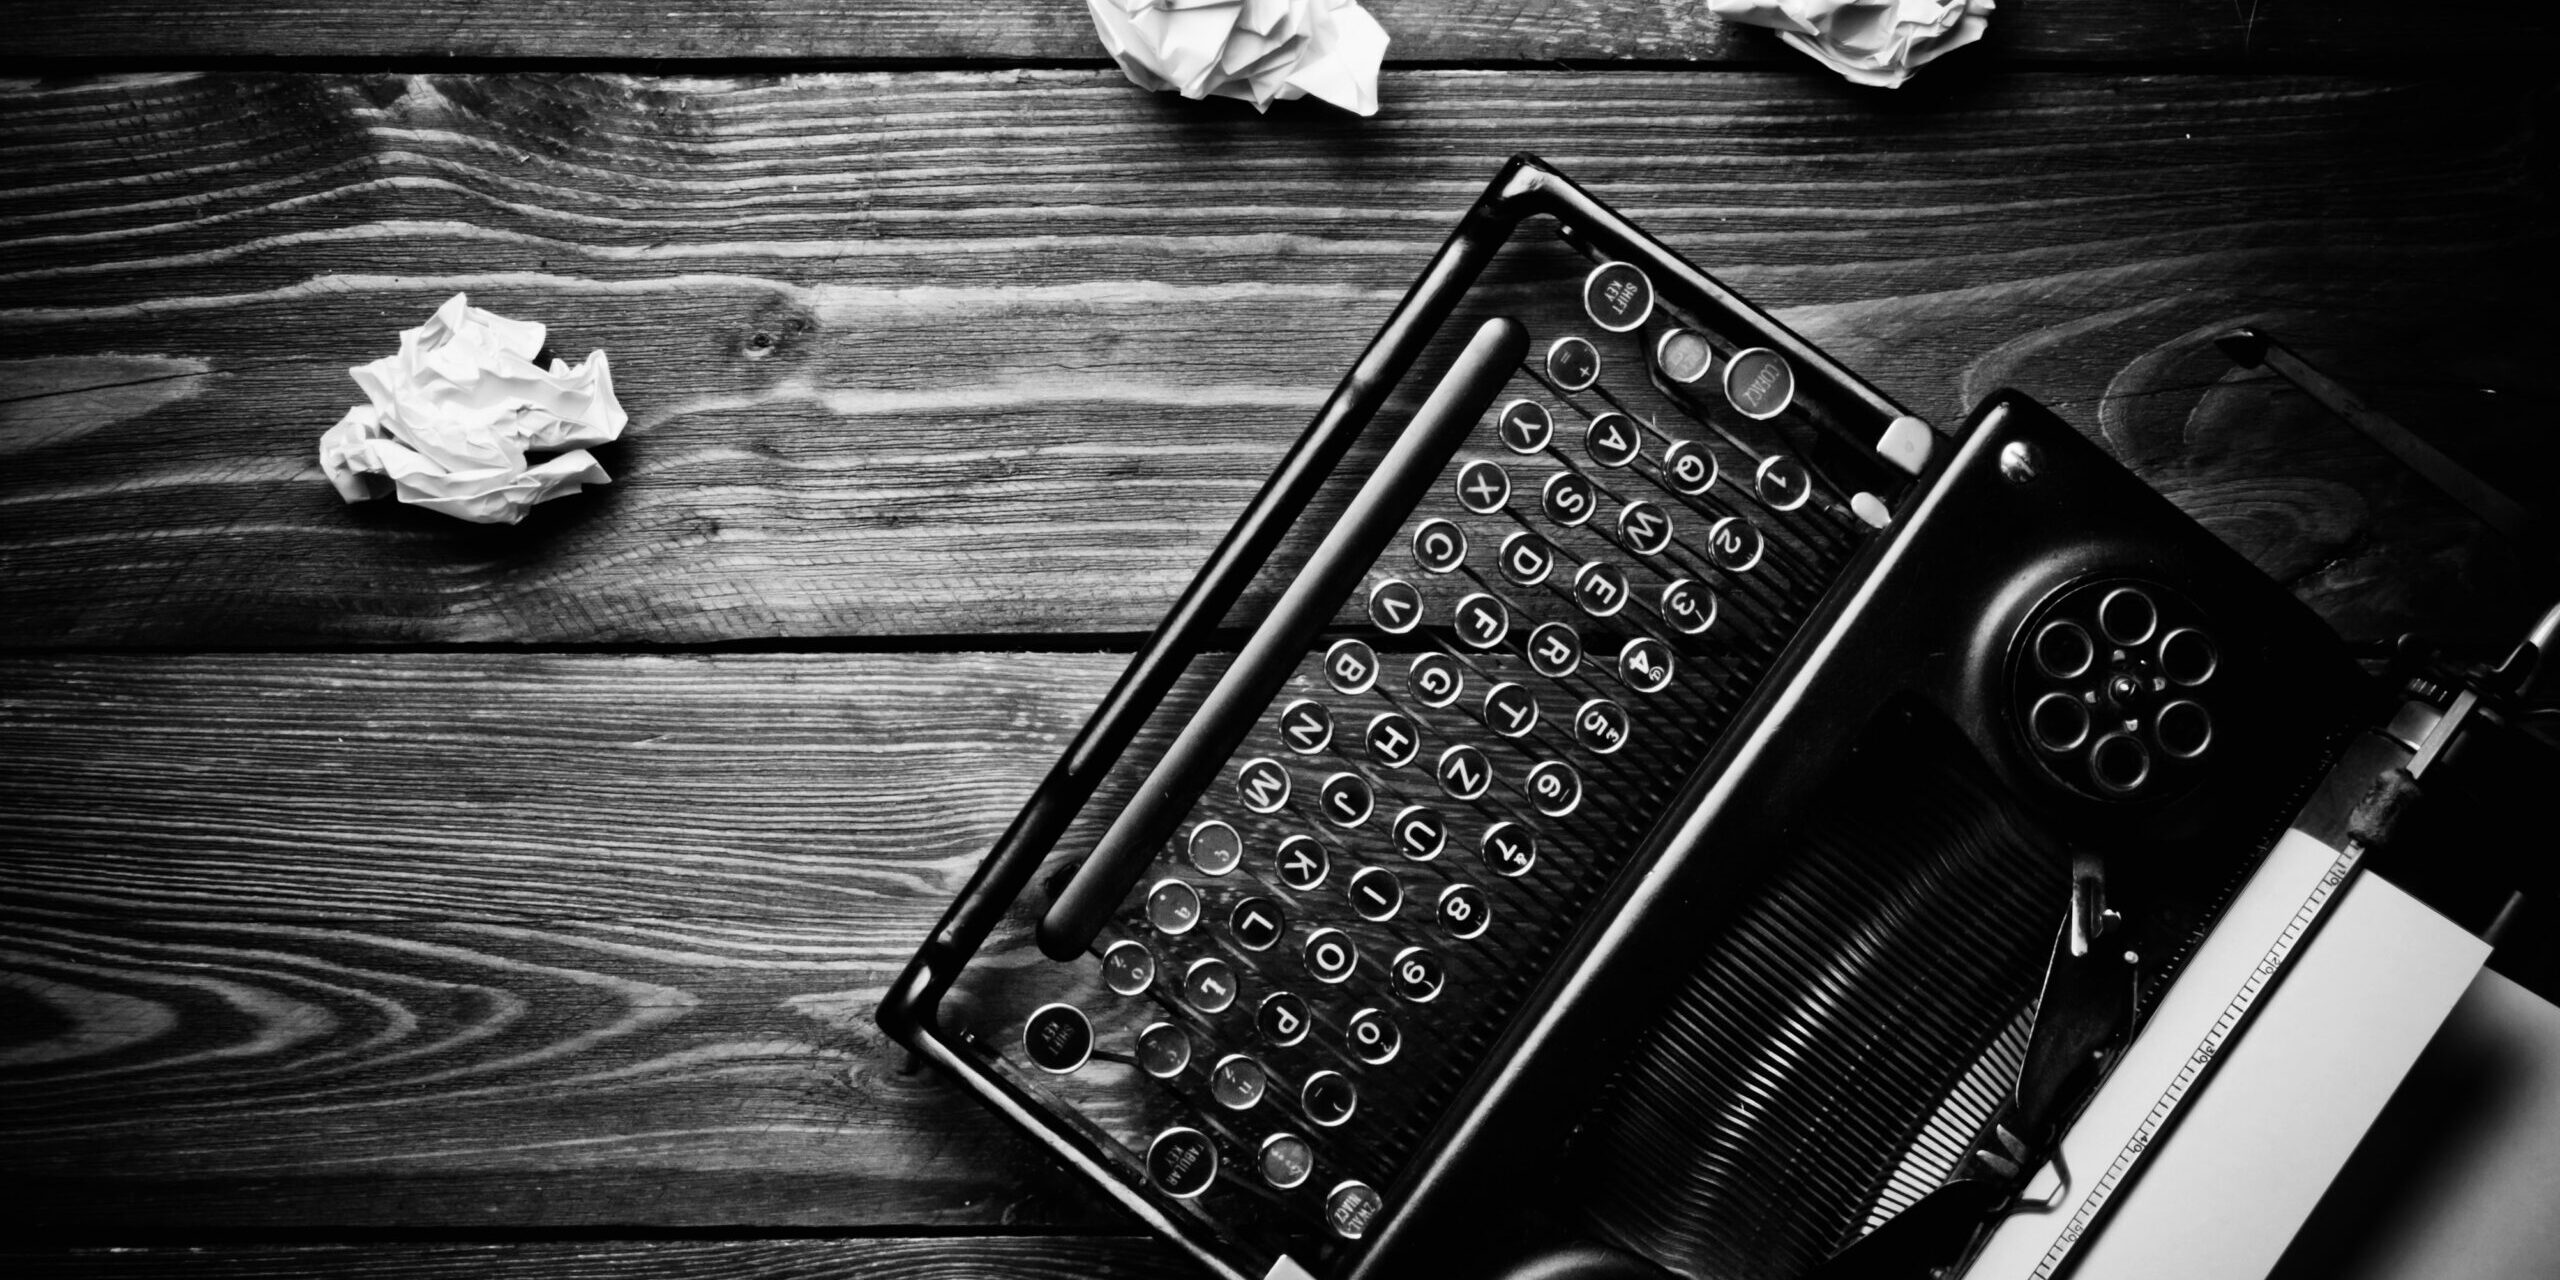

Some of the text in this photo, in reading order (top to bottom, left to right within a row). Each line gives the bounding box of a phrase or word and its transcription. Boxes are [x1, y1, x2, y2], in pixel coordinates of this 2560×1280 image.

[1604, 280, 1623, 302] KEY
[1611, 282, 1638, 315] SHIFT
[1742, 363, 1780, 408] COFACZ
[1512, 416, 1541, 443] Y
[1598, 424, 1627, 451] A
[1674, 455, 1705, 482] Q
[1766, 470, 1786, 488] 1
[1465, 471, 1500, 504] X
[1555, 486, 1584, 513] S
[1626, 511, 1663, 549] W
[1712, 527, 1741, 554] 2
[1424, 532, 1453, 561] C
[1513, 545, 1543, 576] D
[1584, 572, 1617, 604] E
[1382, 597, 1411, 623] V
[1670, 591, 1695, 616] 3
[1473, 607, 1498, 638] F
[1537, 635, 1571, 665] R
[1628, 649, 1650, 674] 4
[1335, 652, 1366, 682] B
[1419, 666, 1451, 695] G
[1288, 711, 1323, 745] N
[1498, 701, 1528, 729] T
[1583, 710, 1609, 736] 5
[1374, 725, 1409, 759] H
[1446, 757, 1480, 791] Z
[1536, 773, 1561, 798] 6
[1244, 769, 1282, 809] M
[1333, 791, 1356, 816] J
[1403, 820, 1436, 852] U
[1494, 837, 1518, 861] 7
[1283, 849, 1317, 885] K
[1362, 885, 1387, 905] I
[1446, 896, 1471, 921] 8
[1241, 910, 1274, 930] L
[1315, 942, 1345, 972] O
[2266, 957, 2281, 975] 20
[1401, 960, 1425, 984] 9
[1041, 1021, 1060, 1041] KEY
[1275, 1005, 1300, 1034] P
[1048, 1024, 1073, 1055] SHIFT
[2200, 1046, 2215, 1064] 30
[1165, 1144, 1184, 1165] KEY
[2133, 1135, 2148, 1153] 40
[1166, 1144, 1204, 1186] TABULAR
[1332, 1191, 1363, 1225] NIACZ
[2069, 1225, 2083, 1242] 50
